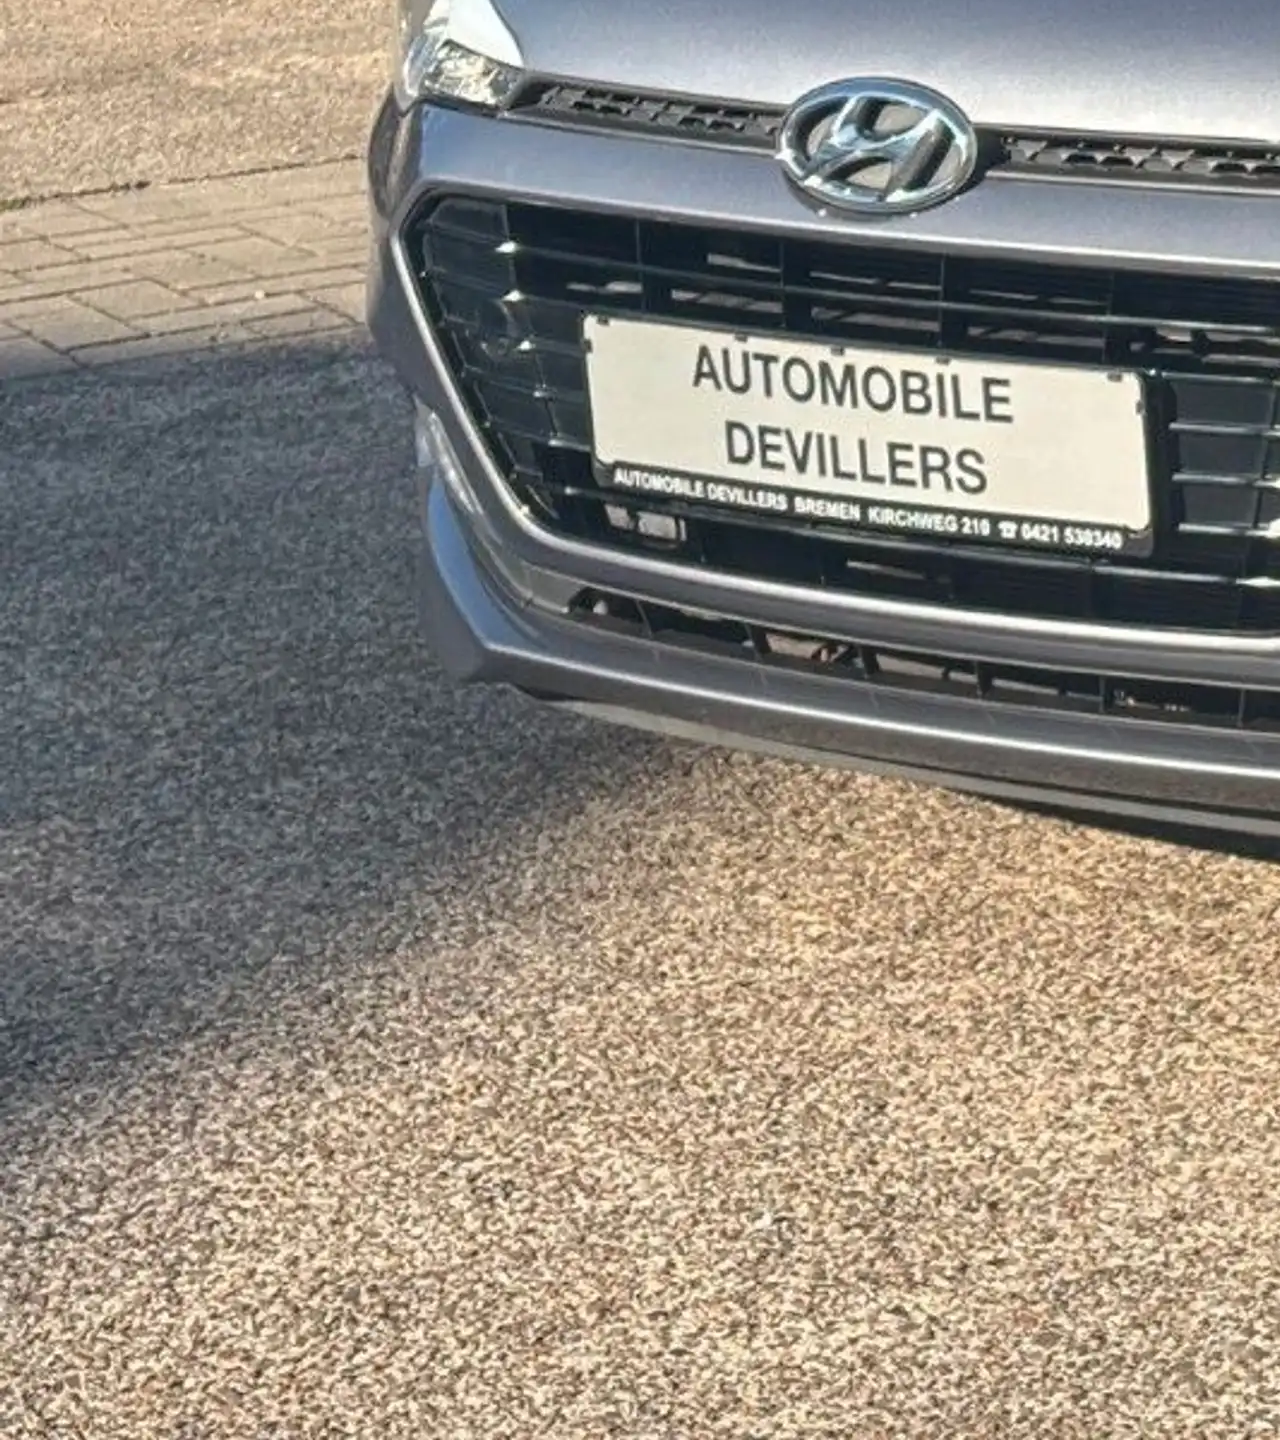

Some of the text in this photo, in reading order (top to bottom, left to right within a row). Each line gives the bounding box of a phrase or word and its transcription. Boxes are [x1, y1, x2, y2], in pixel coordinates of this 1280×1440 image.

[693, 345, 1013, 423] AUTOMOBILE
[725, 420, 987, 494] DEVILLERS
[613, 467, 705, 498] AUTOMOBILE
[707, 478, 788, 510] DEVILLERS
[794, 495, 861, 522] BREMEN
[867, 506, 958, 533] KIRCHWEG
[1021, 523, 1060, 543] 0421
